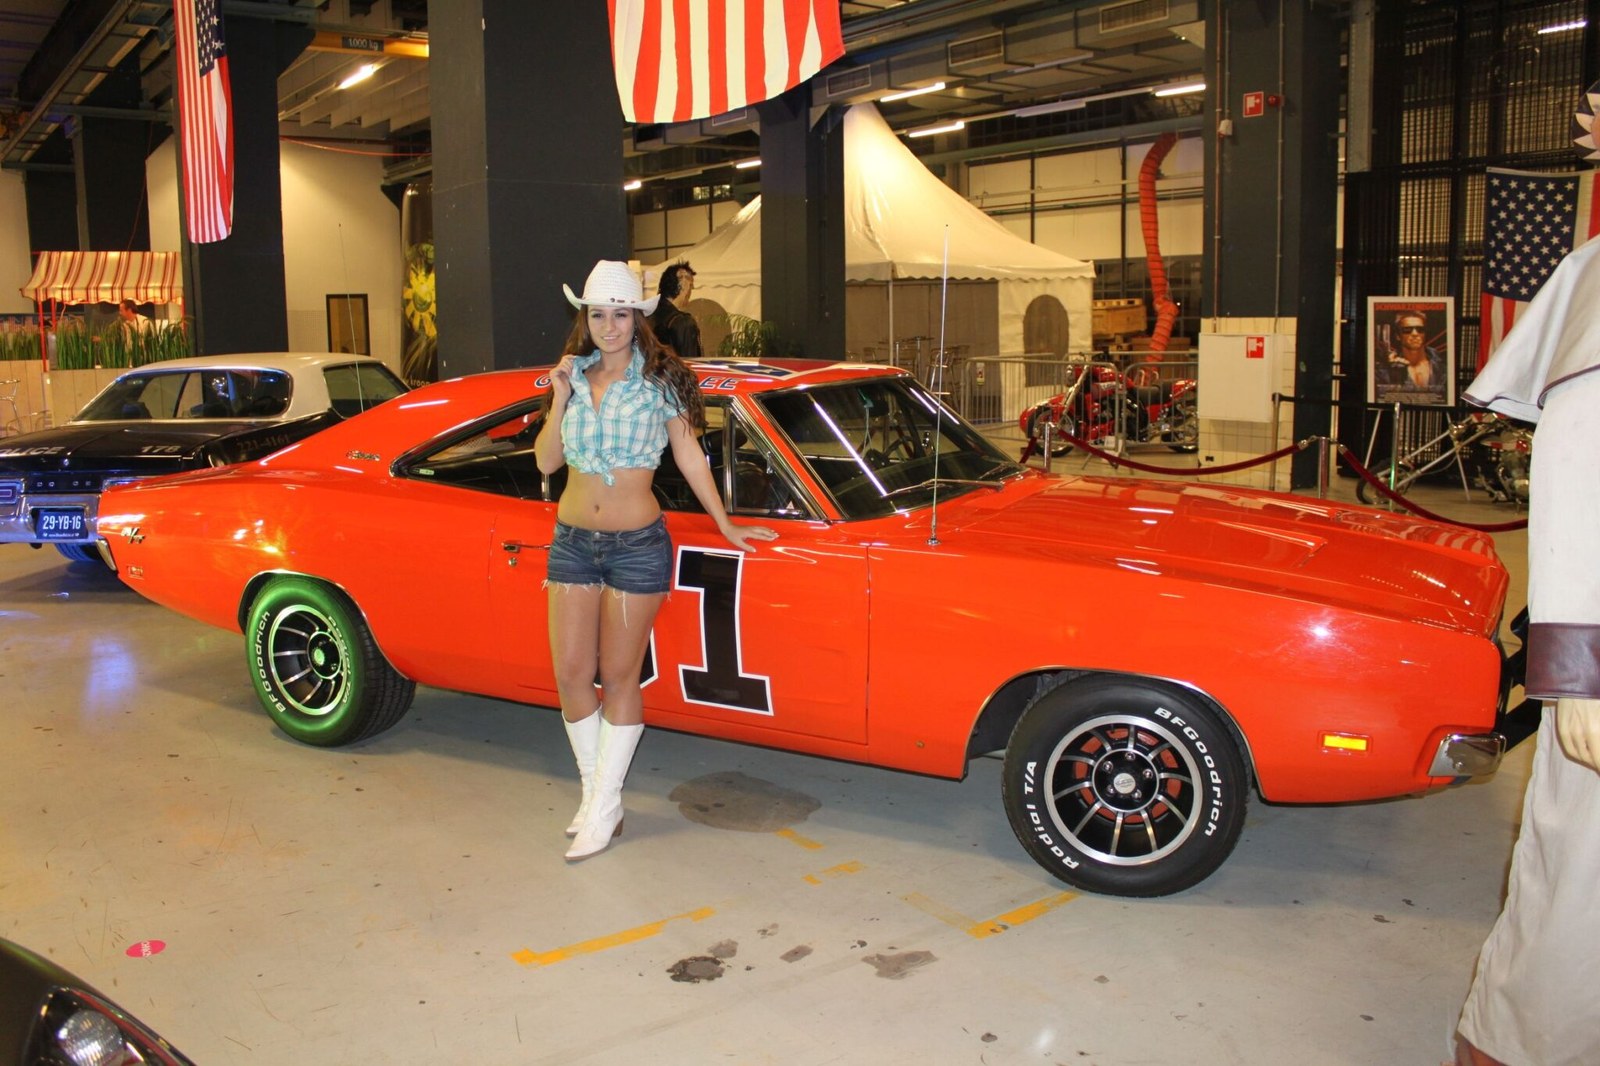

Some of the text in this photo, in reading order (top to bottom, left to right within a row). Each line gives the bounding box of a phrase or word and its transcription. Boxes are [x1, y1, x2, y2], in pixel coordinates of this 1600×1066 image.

[369, 39, 379, 51] kg
[699, 375, 742, 391] EE
[42, 515, 82, 530] 29-YB-16
[255, 611, 287, 713] BFGoodrich
[1154, 706, 1223, 837] BFGoodrich
[1023, 760, 1080, 870] Radial T/A
